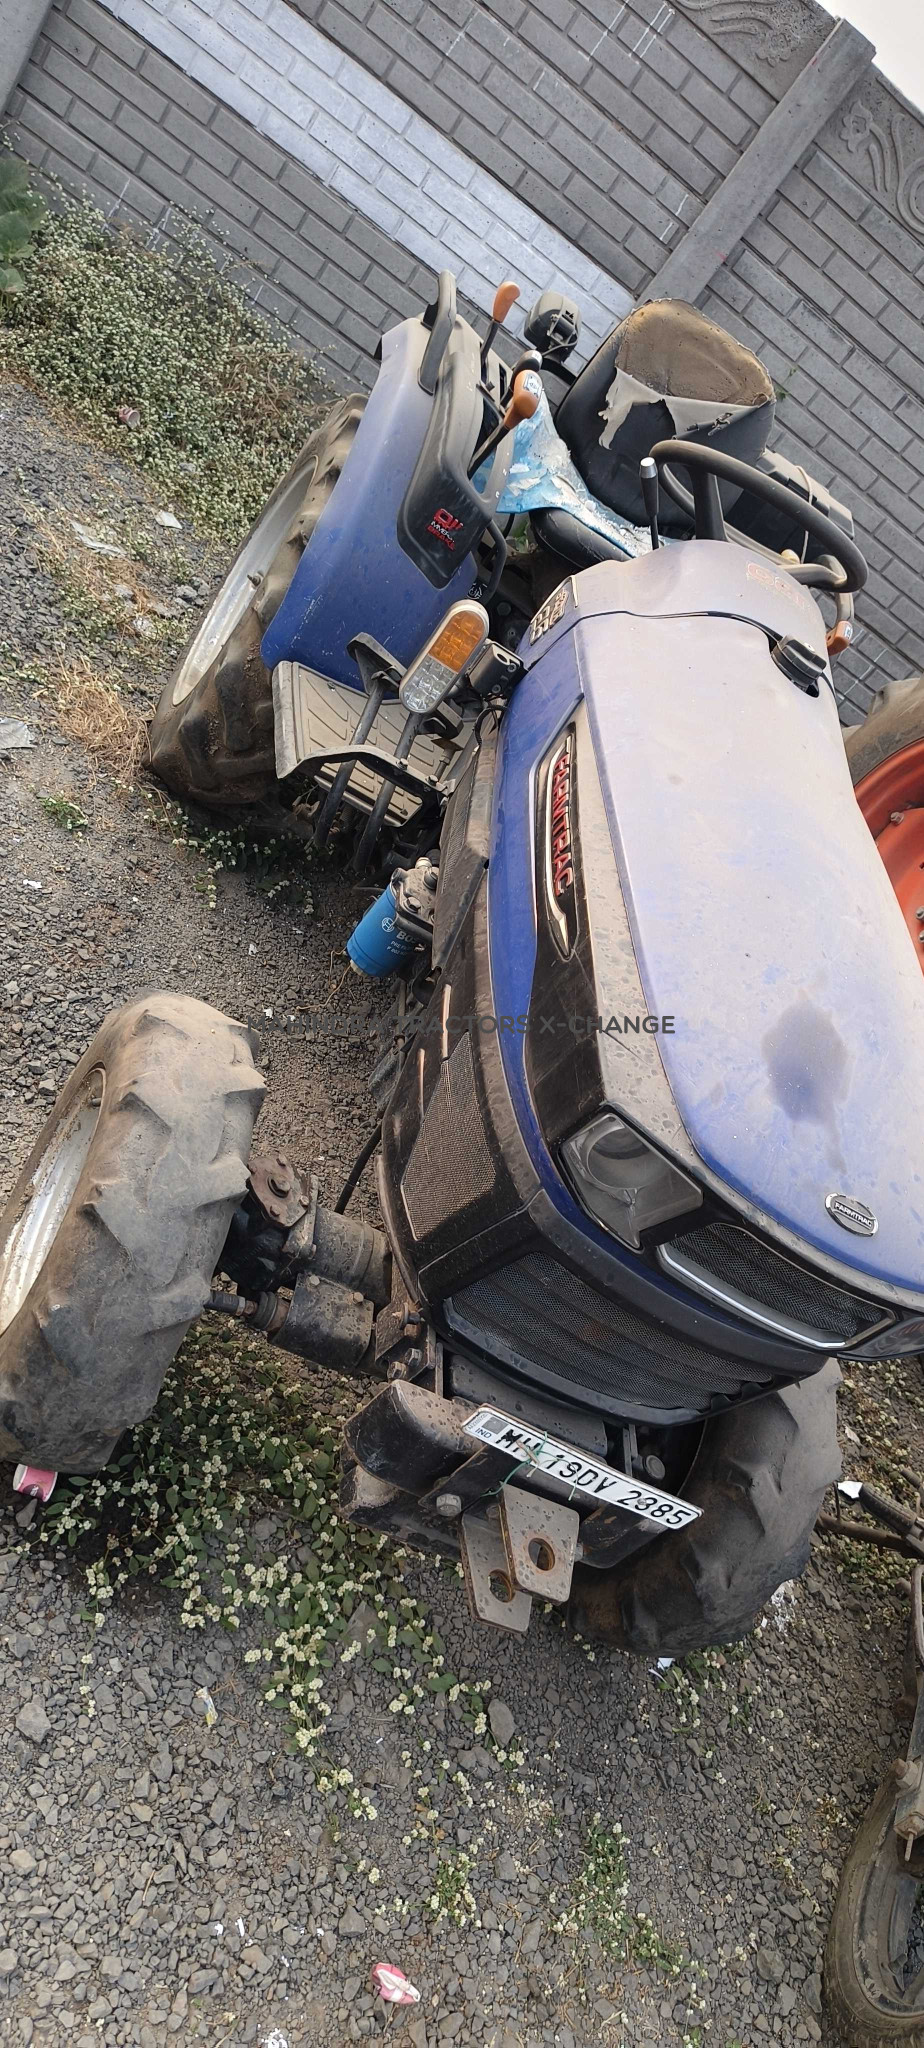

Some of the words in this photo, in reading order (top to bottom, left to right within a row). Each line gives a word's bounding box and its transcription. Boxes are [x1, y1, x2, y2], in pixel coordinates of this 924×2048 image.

[552, 755, 573, 897] FARMTRAC
[834, 1201, 872, 1228] FARMTRAC
[475, 1427, 492, 1439] IND
[616, 1490, 692, 1525] 2385
